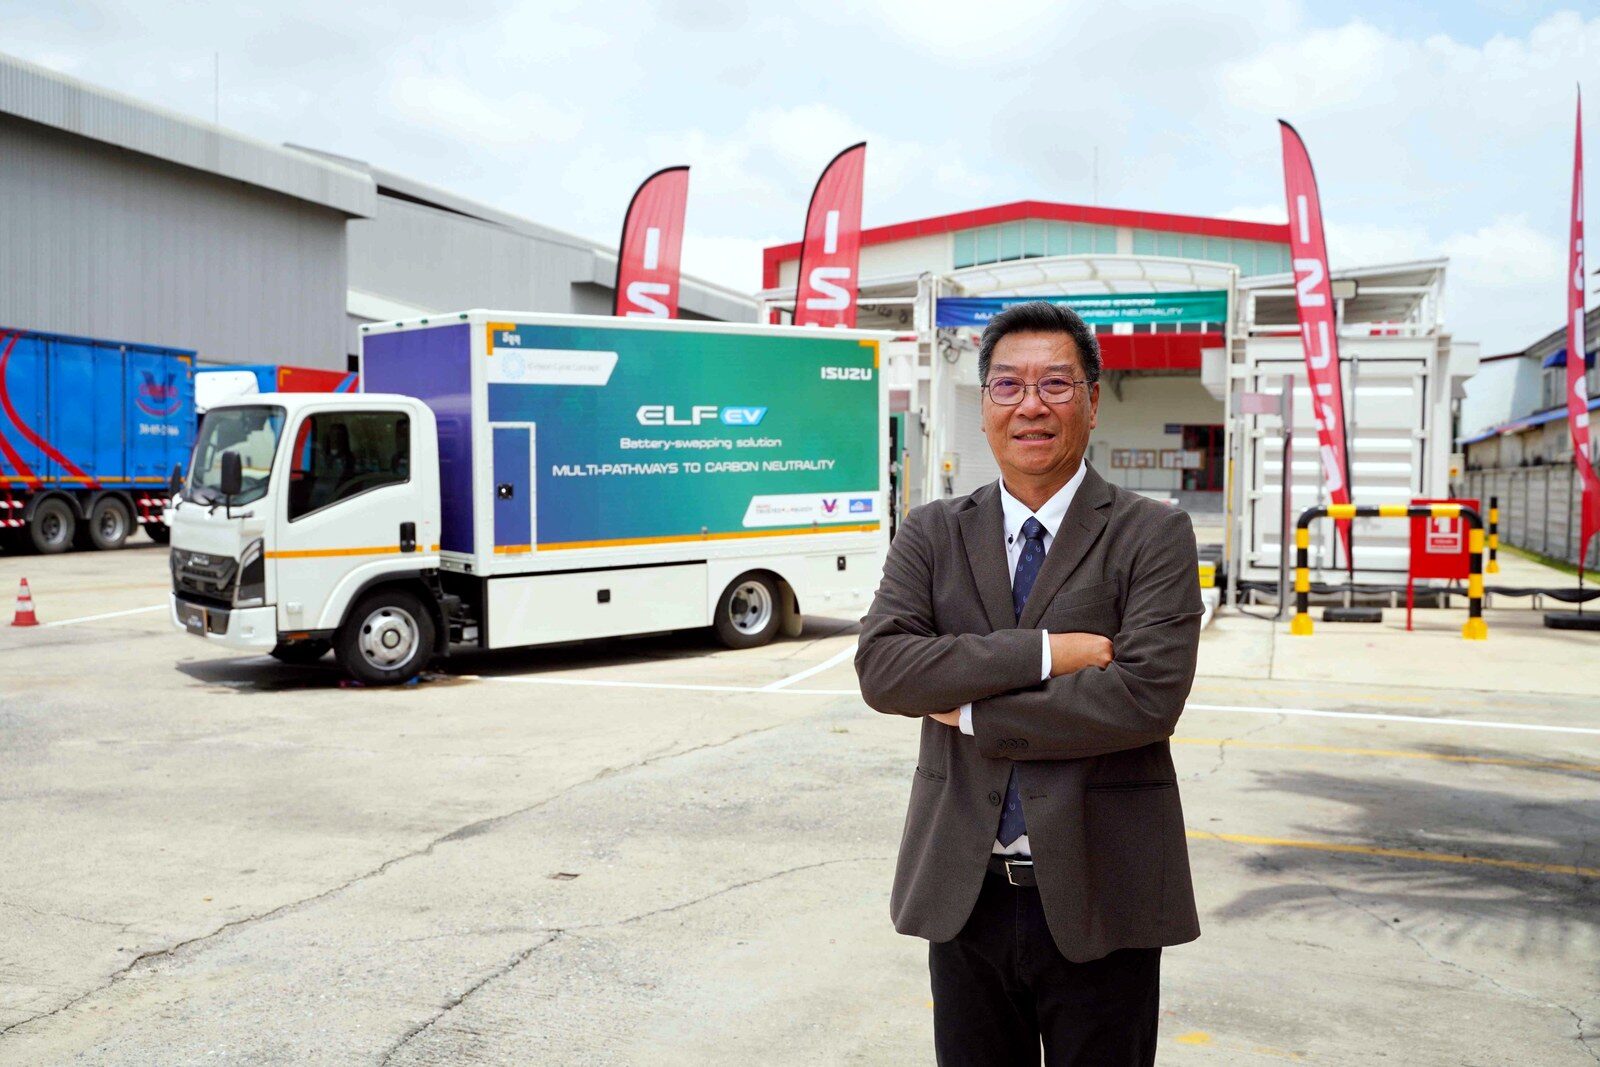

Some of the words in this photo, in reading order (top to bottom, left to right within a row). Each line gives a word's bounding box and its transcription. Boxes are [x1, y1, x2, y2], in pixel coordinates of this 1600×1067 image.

[806, 210, 851, 327] IS
[820, 366, 873, 381] ISUZU
[636, 405, 718, 426] ELF
[723, 408, 762, 425] EV
[620, 437, 733, 450] Battery-swapping
[736, 437, 782, 447] solution
[552, 462, 679, 477] MULTI-PATHWAYS
[683, 462, 702, 473] TO
[705, 461, 759, 472] CARBON
[763, 459, 836, 471] NEUTRALITY
